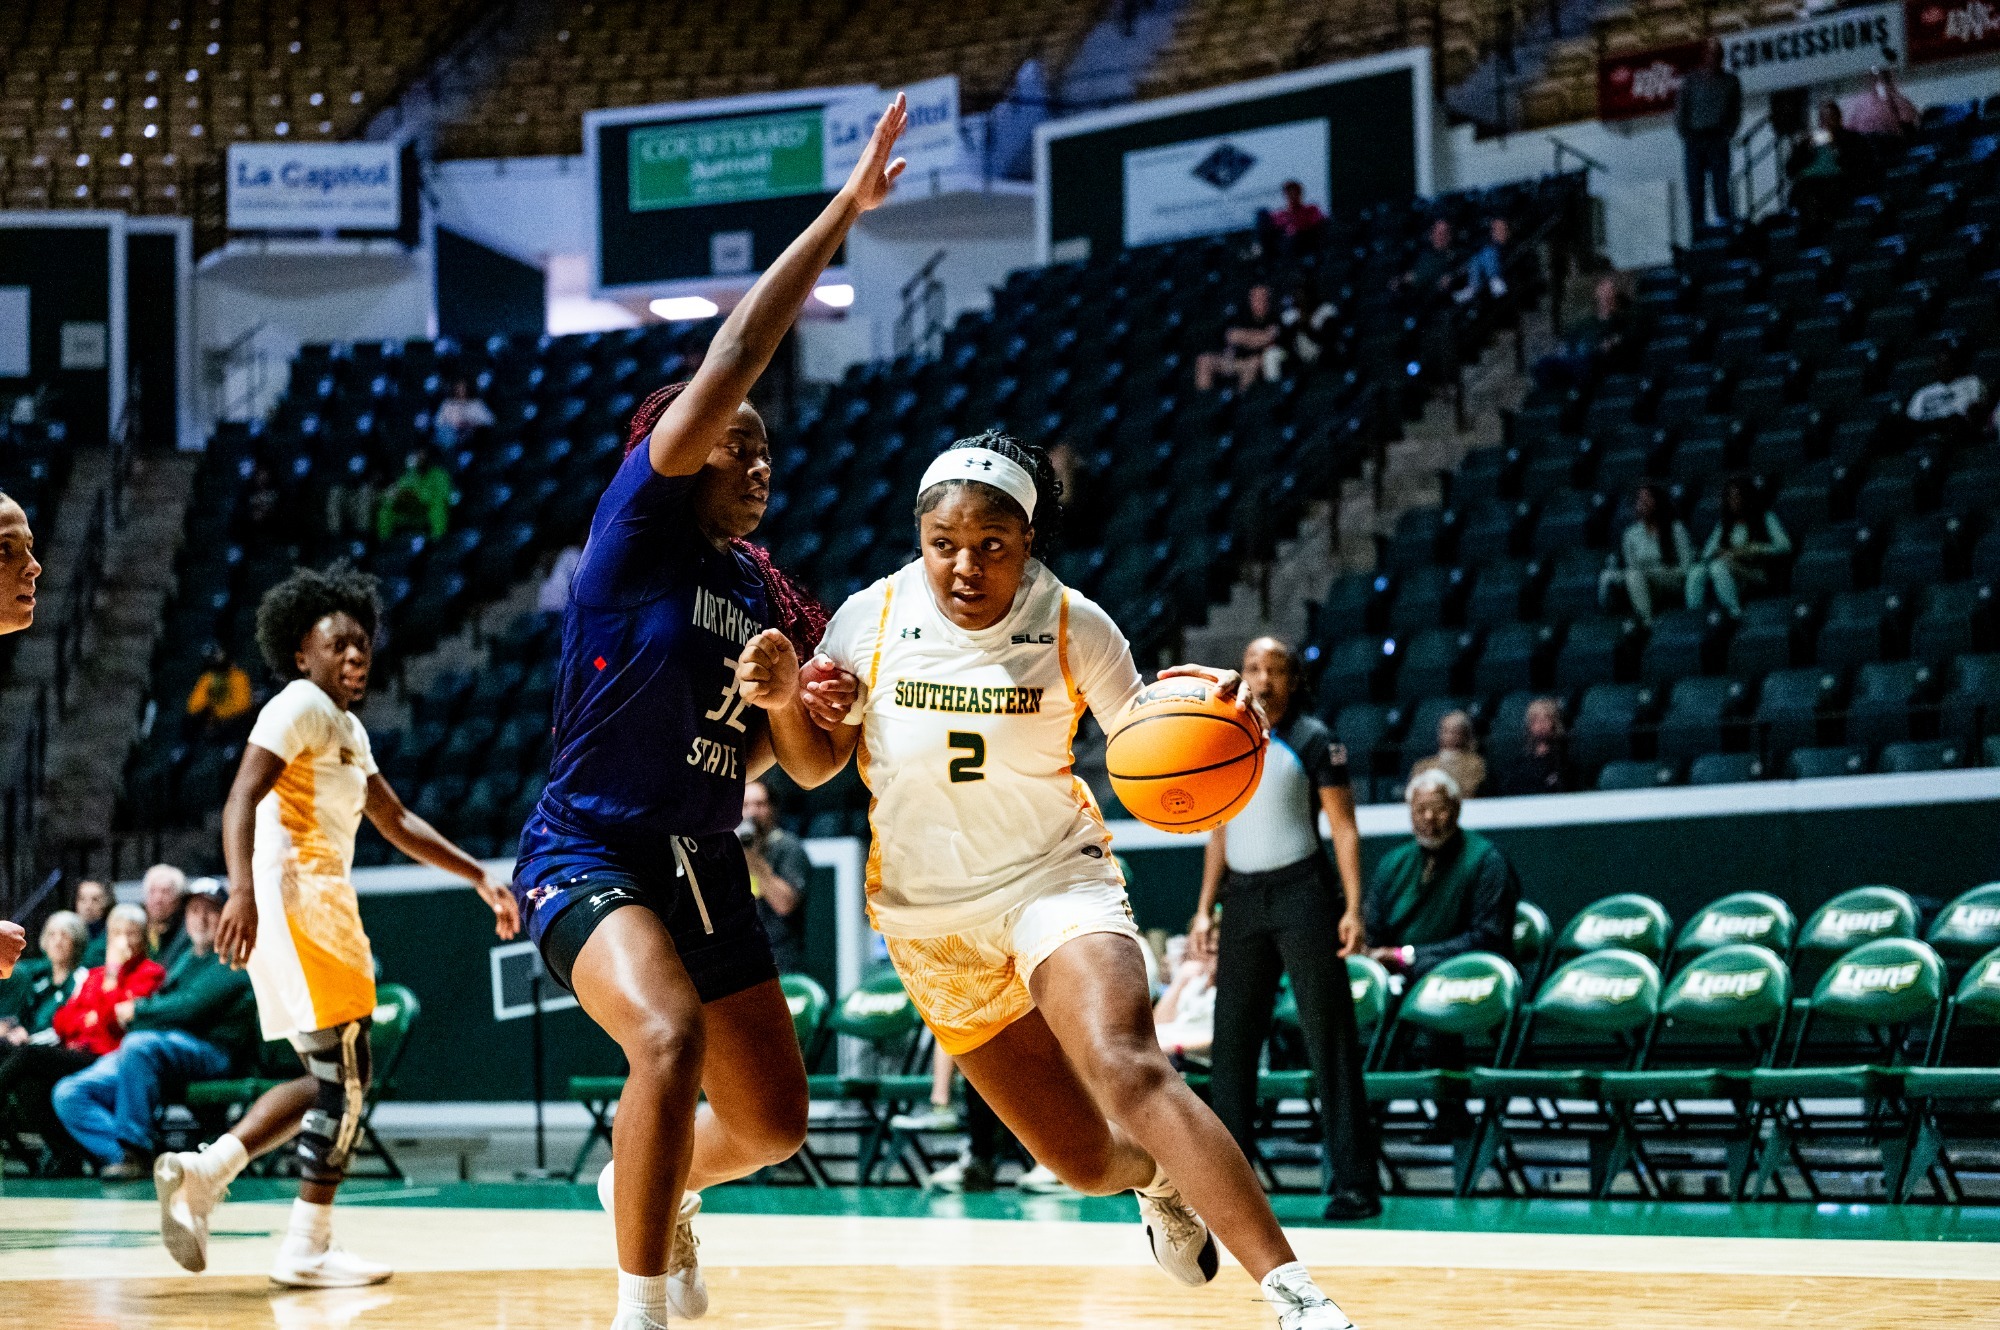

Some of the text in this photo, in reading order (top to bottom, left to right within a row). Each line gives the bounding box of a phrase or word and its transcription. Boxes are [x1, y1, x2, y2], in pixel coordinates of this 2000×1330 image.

[1729, 16, 1889, 69] CONCESSIONS
[863, 101, 949, 139] Citol
[1011, 634, 1055, 645] SLC
[895, 680, 1044, 714] SOUTHEASTERN
[686, 736, 738, 780] STATE
[947, 730, 986, 783] 2
[1697, 912, 1776, 937] Lions
[1819, 909, 1898, 933] Lions
[1419, 975, 1498, 1002] Lions
[1558, 970, 1643, 1000] Lions
[1681, 969, 1769, 998] Lions
[1829, 962, 1921, 994] Lions
